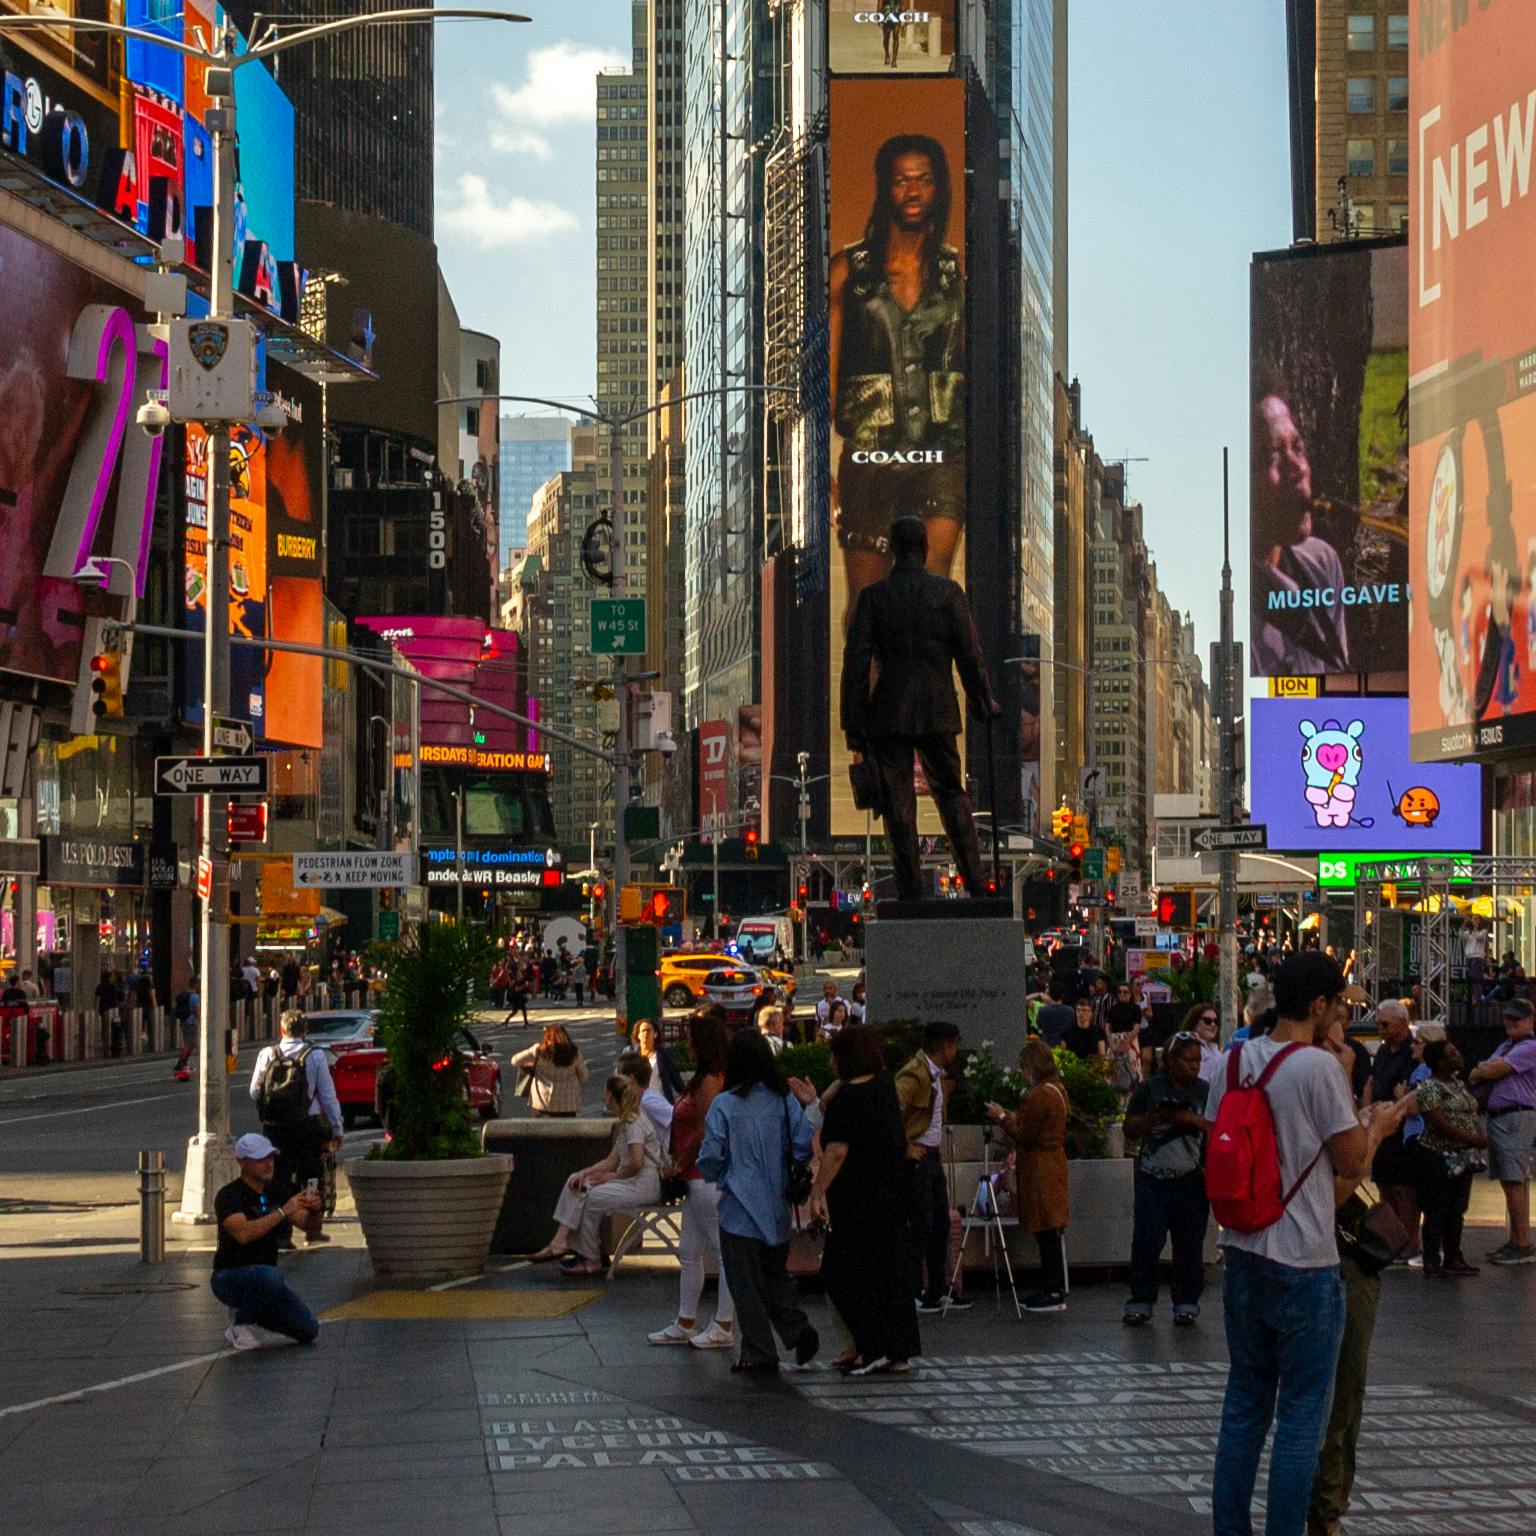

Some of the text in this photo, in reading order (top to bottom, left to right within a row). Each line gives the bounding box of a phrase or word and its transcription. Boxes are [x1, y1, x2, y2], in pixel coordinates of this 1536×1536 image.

[853, 10, 930, 24] COACH
[851, 448, 944, 465] COACH
[428, 490, 446, 570] 1500
[277, 533, 317, 561] BURBERRY
[1267, 587, 1336, 611] MUSIC
[1340, 583, 1400, 606] GAVE
[611, 604, 625, 616] TO
[598, 620, 624, 631] W 45
[527, 754, 545, 769] GAP
[173, 768, 254, 785] ONE WAY
[1201, 830, 1258, 845] ONE WAY
[79, 842, 107, 866] POLO
[298, 855, 404, 869] PEDESTRIAN FLOW ZONE
[481, 849, 545, 864] domination
[345, 870, 404, 883] KEEP MOVING
[495, 869, 541, 886] Beasley
[1319, 861, 1347, 879] DS
[1120, 886, 1139, 896] 25
[492, 1417, 683, 1434] BELASCO
[494, 1430, 730, 1452] LYCEUM
[498, 1446, 778, 1470] PALACE
[675, 1463, 821, 1482] CORT
